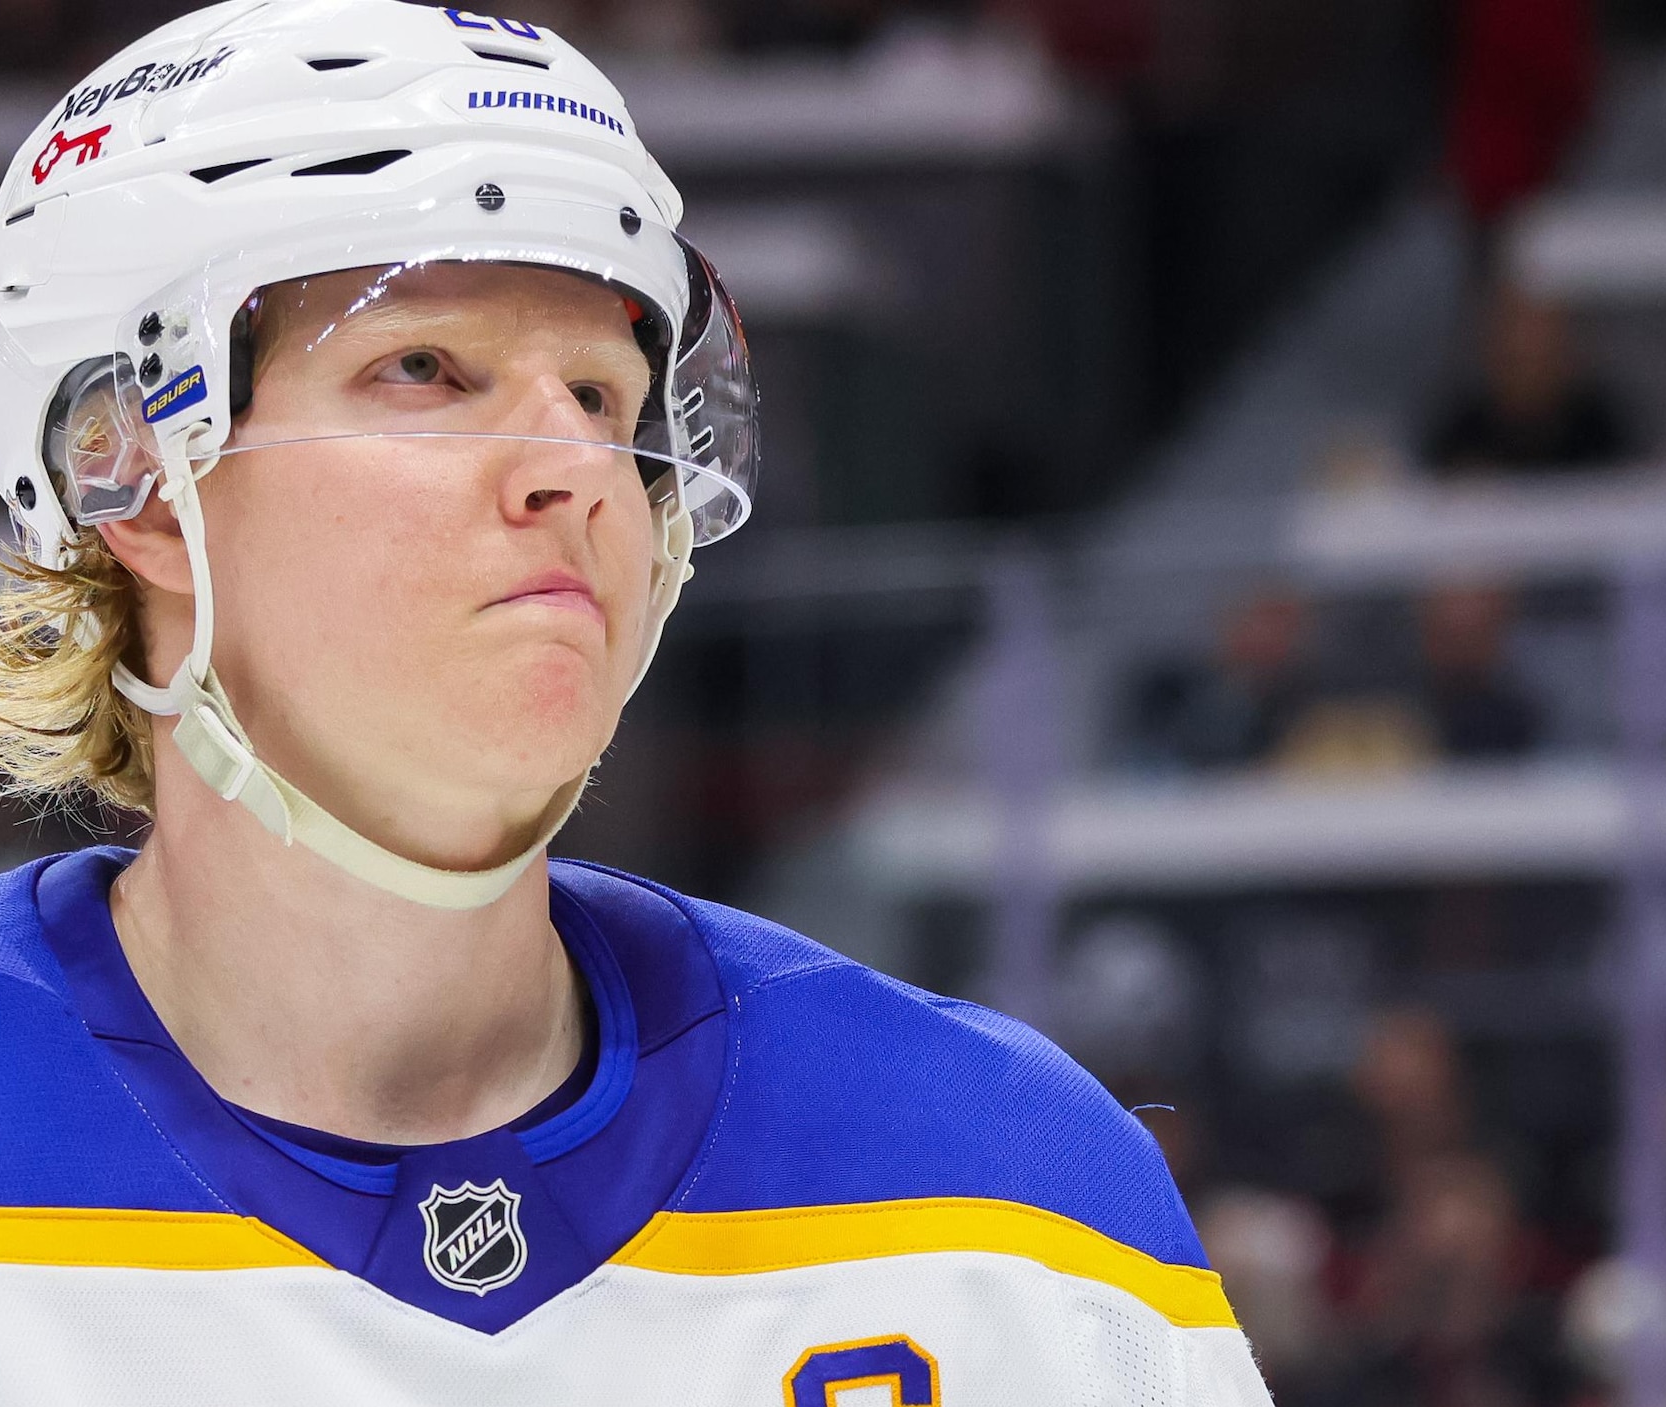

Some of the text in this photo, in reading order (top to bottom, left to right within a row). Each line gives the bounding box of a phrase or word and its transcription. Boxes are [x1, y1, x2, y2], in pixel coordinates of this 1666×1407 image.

[468, 91, 625, 136] WARRIOR
[146, 371, 201, 419] BAUER
[447, 1210, 502, 1271] NHL
